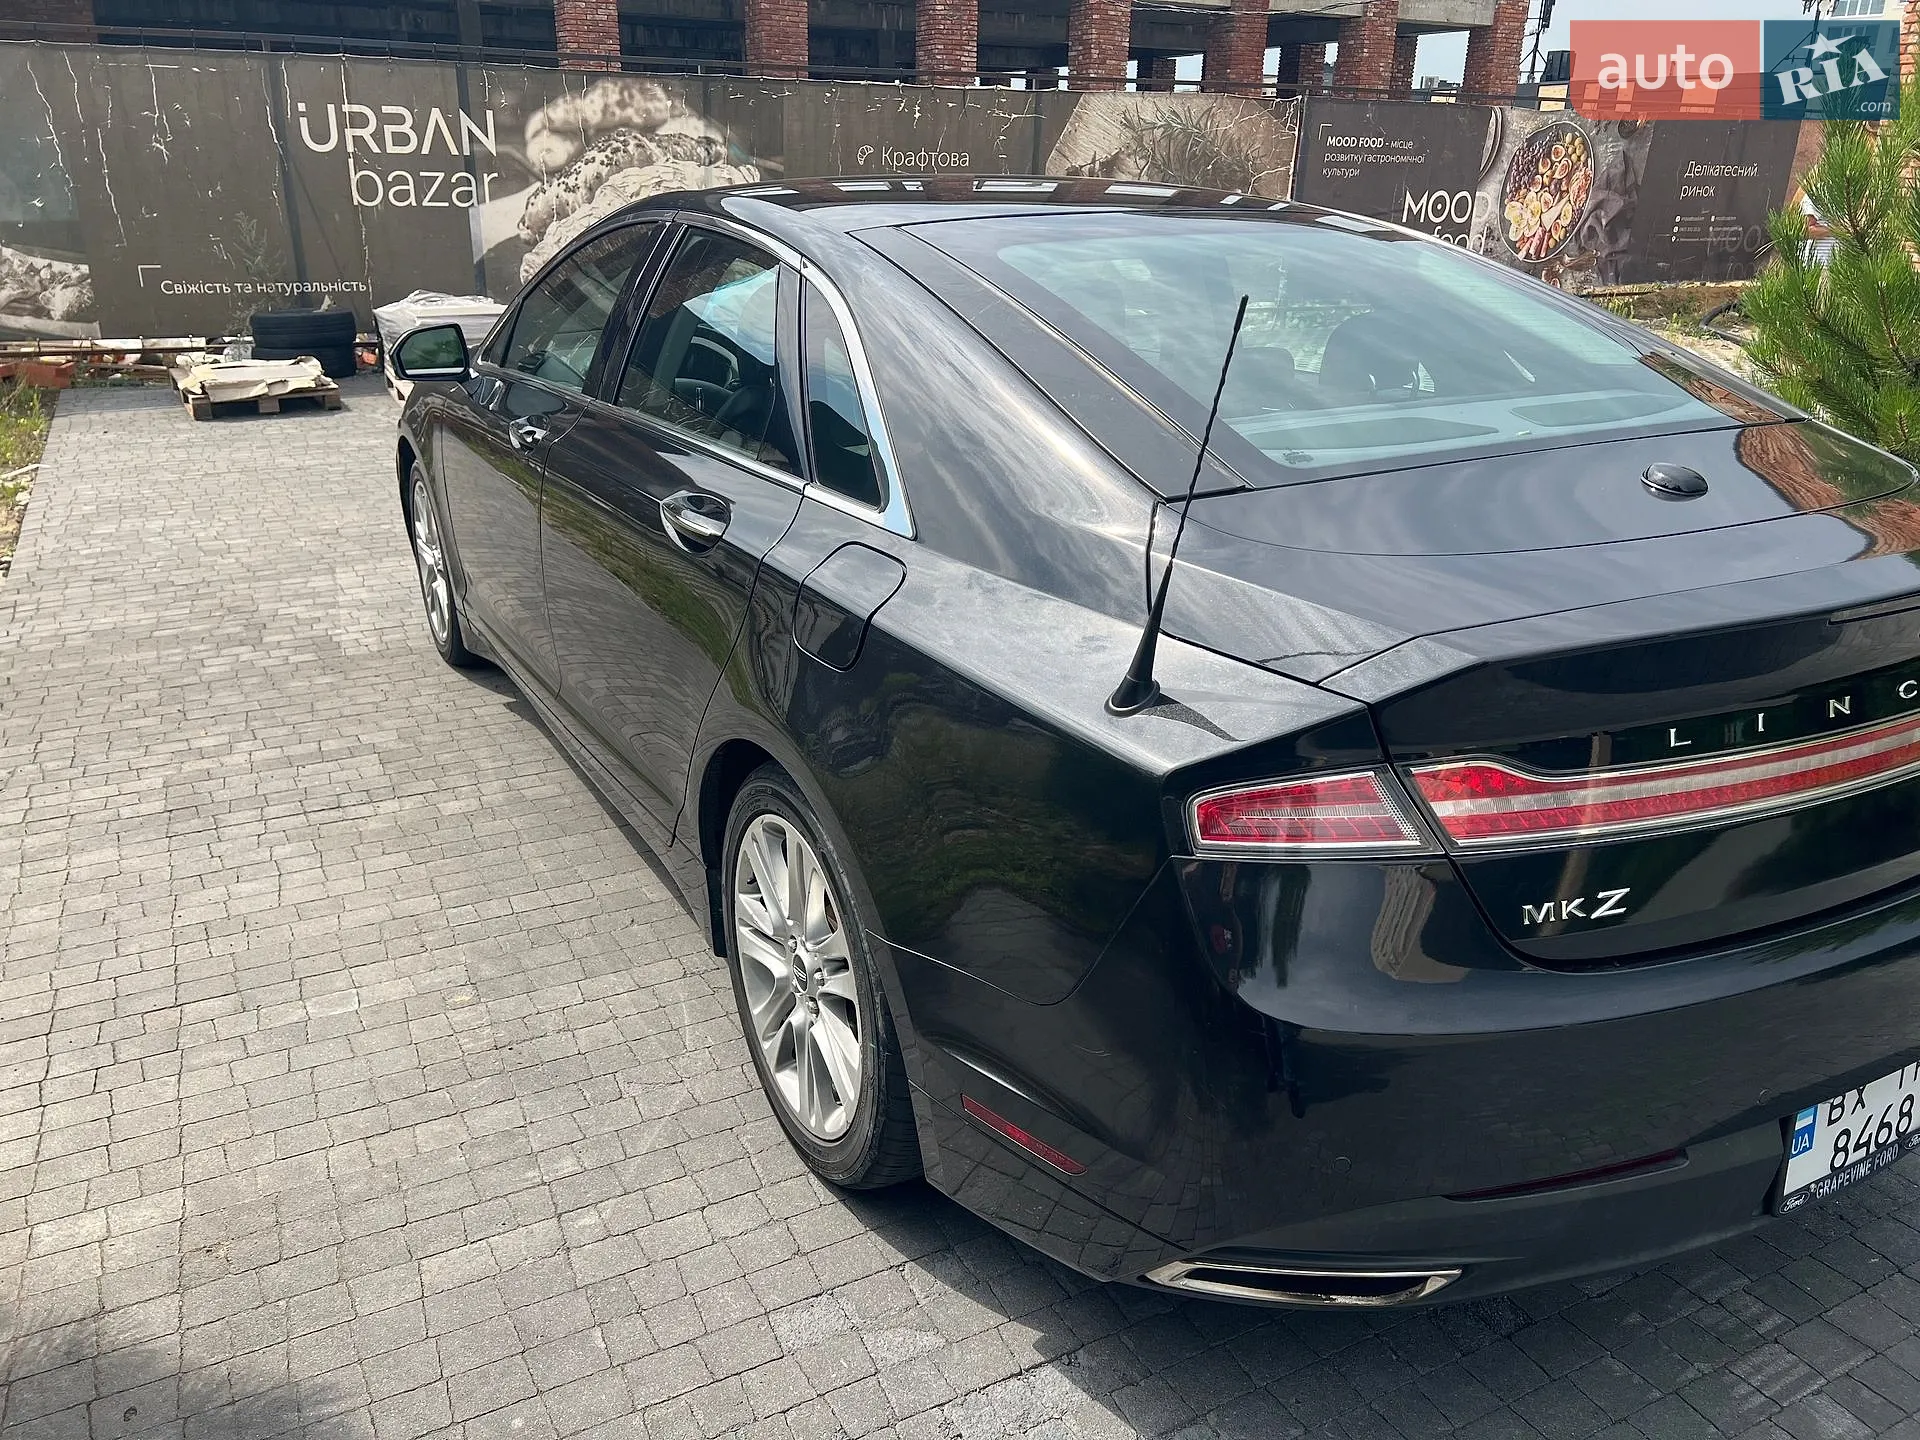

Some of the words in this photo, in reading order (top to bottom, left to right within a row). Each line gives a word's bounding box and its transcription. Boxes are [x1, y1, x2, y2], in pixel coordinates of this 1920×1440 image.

[1326, 136, 1358, 148] MOOD
[1359, 137, 1384, 148] FOOD
[1390, 140, 1414, 150] місце
[881, 146, 970, 171] Крафтова
[1324, 151, 1363, 164] розвитку
[1363, 153, 1426, 165] гастрономічної
[1322, 166, 1361, 178] культури
[1684, 161, 1758, 178] Делікатесний
[348, 158, 499, 208] bazar
[1680, 185, 1716, 200] ринок
[1402, 189, 1491, 224] MOOD
[160, 279, 231, 295] Свіжість
[234, 281, 253, 294] та
[257, 279, 367, 296] натуральність
[1521, 887, 1631, 926] MKZ
[1829, 1094, 1915, 1173] 8468
[1791, 1133, 1810, 1155] UA
[1816, 1157, 1873, 1199] GRAPEVINE
[1873, 1143, 1899, 1171] FORD
[1783, 1194, 1806, 1212] Ford
